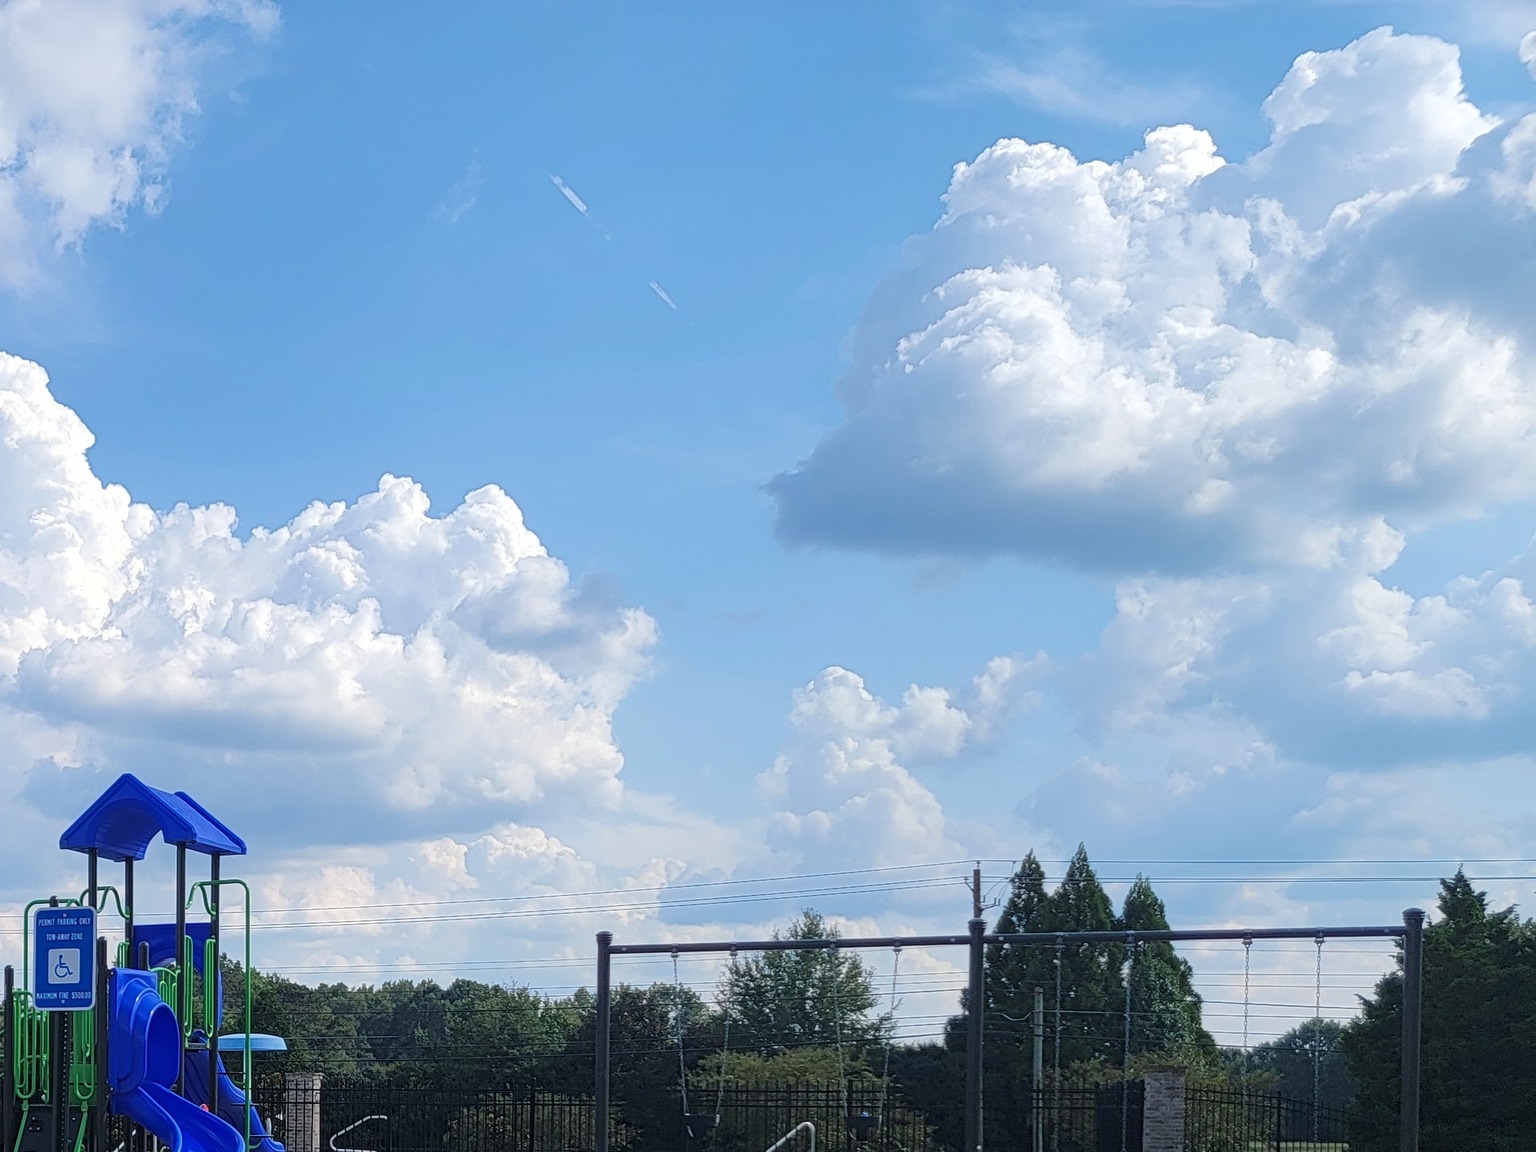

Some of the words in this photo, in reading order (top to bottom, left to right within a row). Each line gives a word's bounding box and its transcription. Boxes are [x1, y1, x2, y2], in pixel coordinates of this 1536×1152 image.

[38, 918, 55, 926] PERMIT
[79, 917, 91, 925] ONLY
[46, 933, 70, 941] TOW-AWAY
[71, 932, 84, 940] ZONE
[71, 991, 91, 999] $500.00
